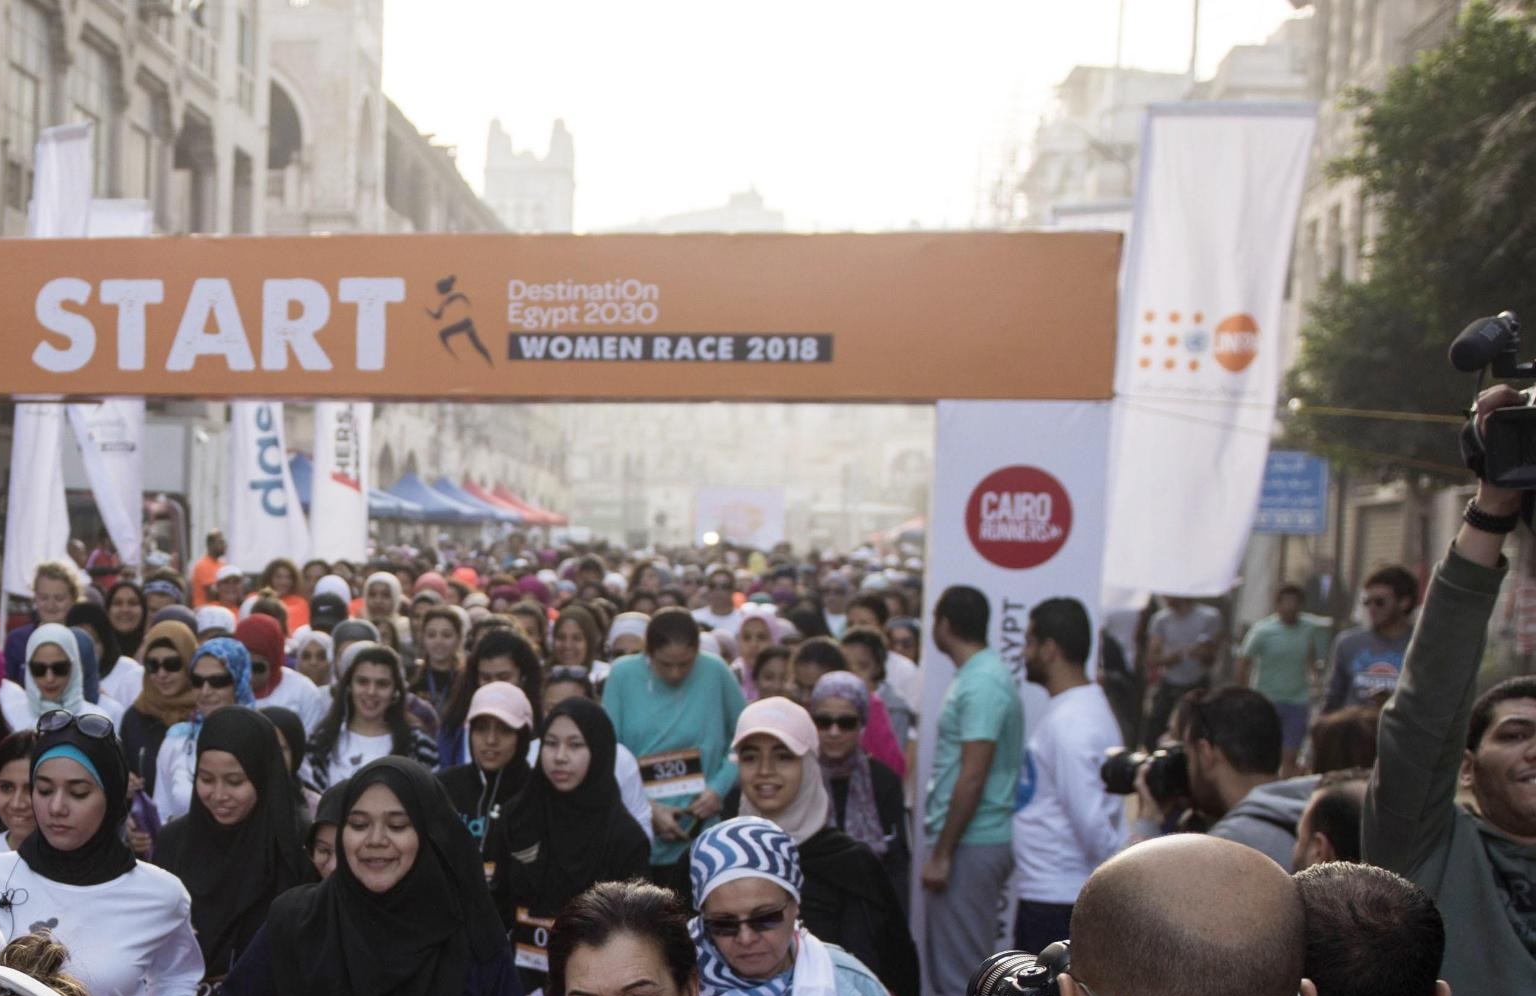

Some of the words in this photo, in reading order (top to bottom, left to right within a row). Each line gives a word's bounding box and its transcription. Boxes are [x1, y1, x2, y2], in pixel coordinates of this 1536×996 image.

[31, 276, 406, 374] START
[507, 302, 580, 329] Egypt
[519, 335, 643, 360] WOMEN
[652, 336, 735, 361] RACE
[745, 336, 820, 362] 2018
[980, 491, 1053, 521] CAIRO
